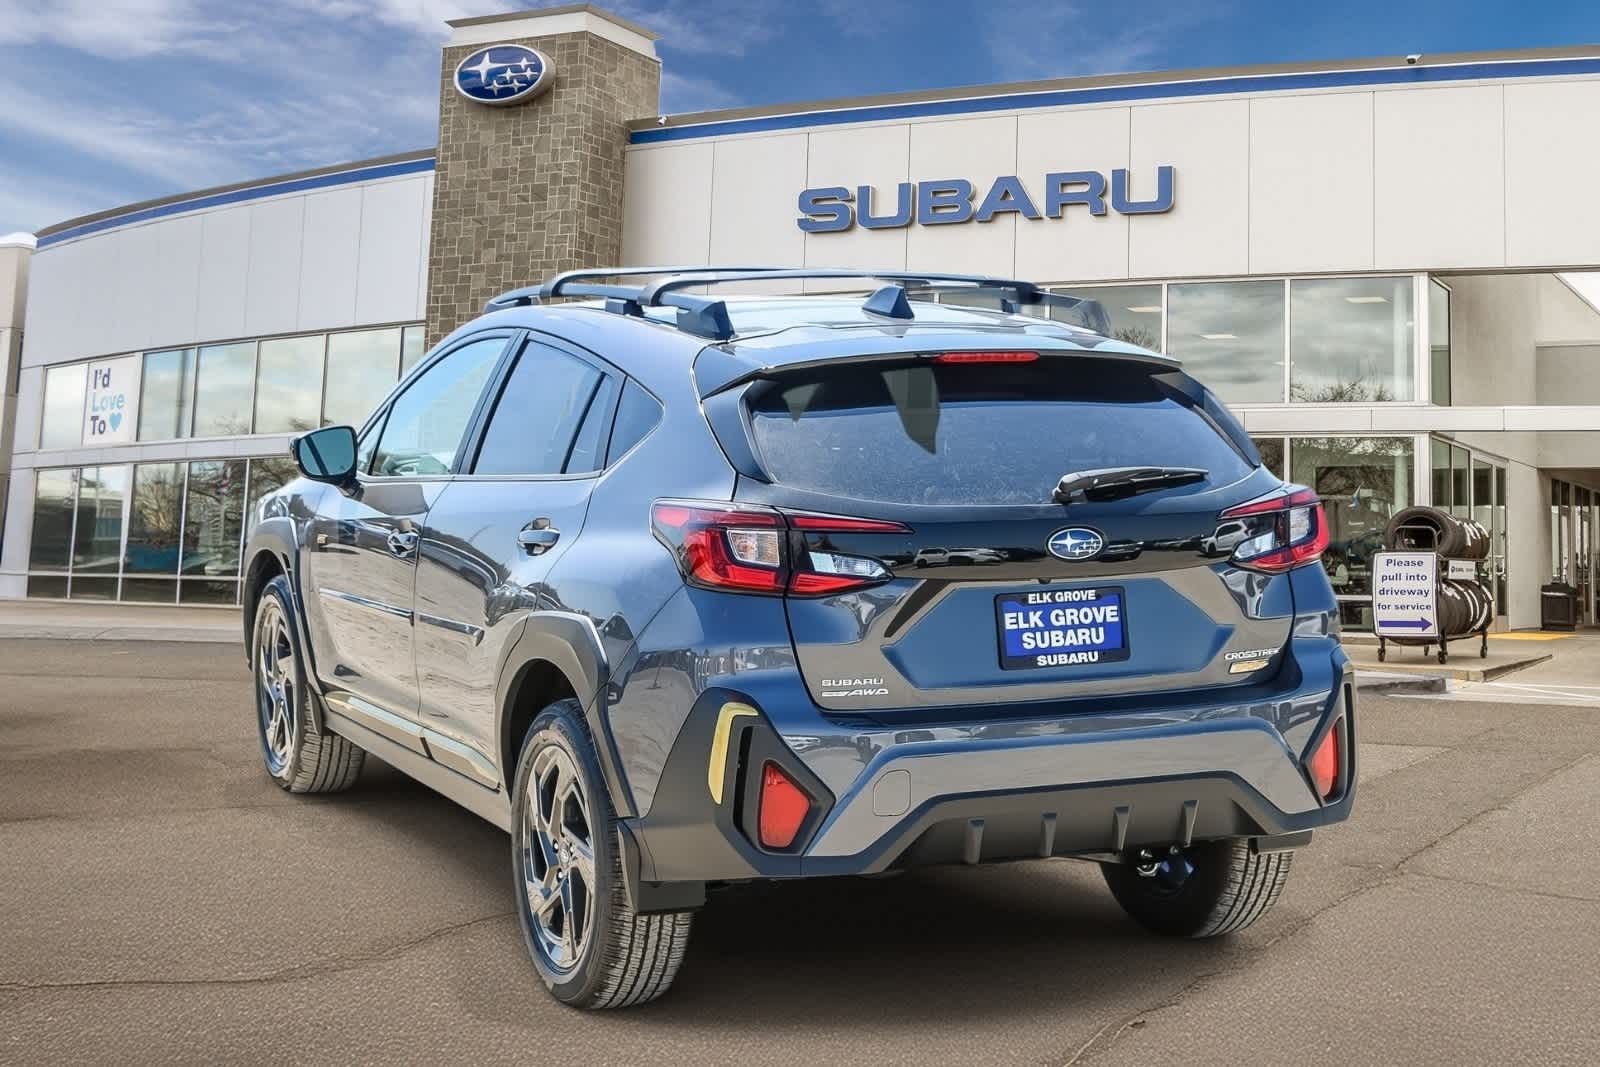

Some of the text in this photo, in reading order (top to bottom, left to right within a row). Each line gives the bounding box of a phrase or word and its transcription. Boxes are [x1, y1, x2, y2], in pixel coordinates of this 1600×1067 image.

[797, 165, 1175, 234] SUBARU
[93, 367, 111, 390] I'd
[91, 391, 125, 413] Love
[90, 415, 106, 435] To
[1386, 558, 1424, 567] Please
[1381, 572, 1428, 584] pull into
[1028, 589, 1096, 604] ELK GROVE
[1378, 587, 1430, 598] driveway
[1004, 605, 1119, 630] ELK GROVE
[1022, 626, 1105, 650] SUBARU
[1036, 651, 1099, 667] SUBARU
[821, 677, 884, 687] SUBARU
[847, 688, 889, 697] AWD
